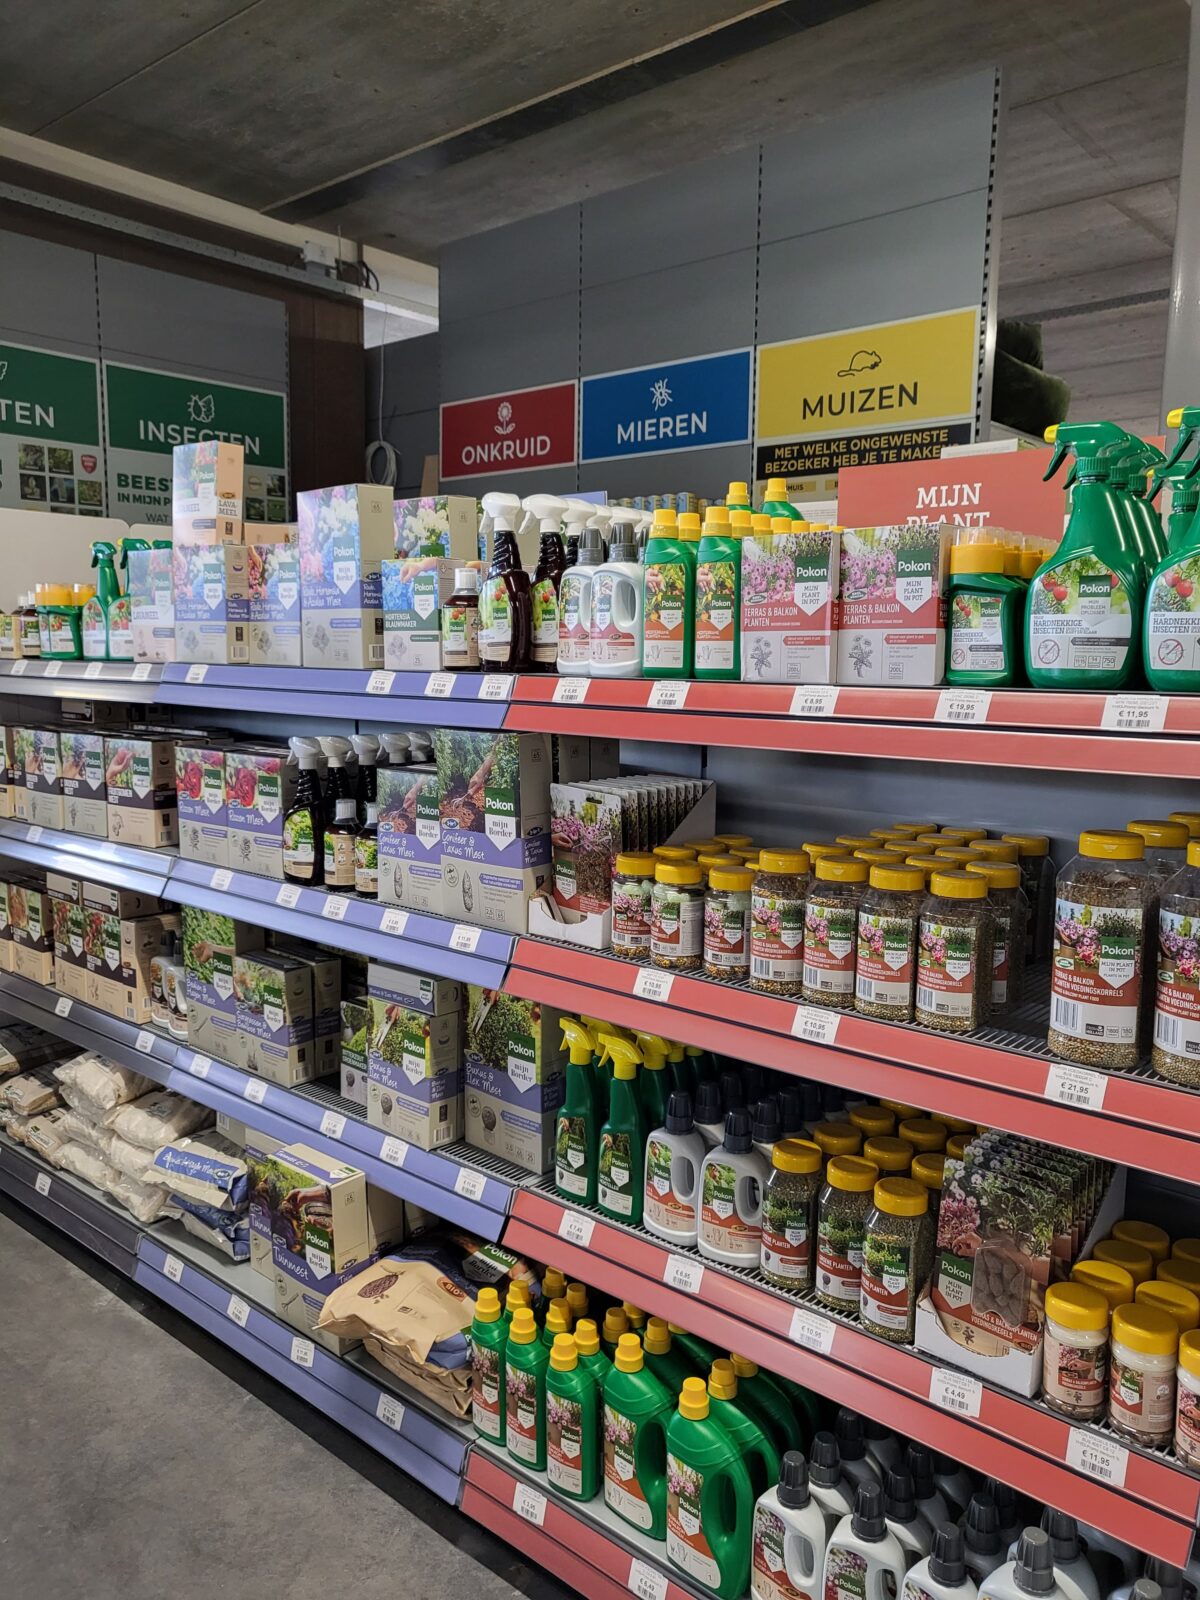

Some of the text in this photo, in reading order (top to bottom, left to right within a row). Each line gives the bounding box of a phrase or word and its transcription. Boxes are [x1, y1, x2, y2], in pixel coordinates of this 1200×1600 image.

[802, 381, 918, 420] MUIZEN
[617, 410, 709, 445] MIEREN
[139, 419, 260, 455] INSECTEN
[461, 435, 552, 466] ONKRUID
[774, 429, 950, 464] MET WELKE ONGEWENSTE
[765, 443, 960, 475] BEZOEKER HEB JE TE MAKE
[117, 492, 130, 504] IN
[132, 494, 164, 508] MIJN
[915, 482, 983, 510] MIJN
[145, 513, 169, 524] WAT
[796, 565, 829, 578] Pokon
[898, 560, 932, 573] Pokon
[414, 582, 435, 596] Pokon
[906, 580, 921, 588] MIJN
[1079, 583, 1111, 595] Pokon
[801, 591, 821, 599] PLANT
[903, 587, 923, 595] PLANT
[661, 600, 681, 608] Pokon
[711, 599, 731, 607] Pokon
[801, 598, 821, 606] IN POT
[903, 594, 923, 602] IN POT
[744, 607, 798, 617] TERRAS & BALKON
[843, 602, 901, 614] TERRAS & BALKON
[981, 607, 999, 615] Pokon
[386, 620, 417, 630] BLAUWMAKER
[744, 617, 770, 628] PLANTEN
[843, 614, 871, 626] PLANTEN
[1033, 619, 1083, 628] HARDNEKKIGE
[1032, 627, 1065, 636] INSECTEN
[1152, 625, 1190, 635] INSECTEN
[804, 697, 810, 705] €
[949, 702, 976, 712] € 19,95
[1118, 710, 1149, 719] € 11,95
[258, 782, 278, 794] Pokon
[416, 803, 440, 816] Pokon
[485, 796, 514, 813] Pokon
[421, 823, 435, 833] mijn
[492, 819, 508, 830] mijn
[418, 830, 439, 841] Border
[441, 830, 467, 846] Conifeer
[488, 827, 513, 839] Border
[379, 843, 416, 860] Taxus Mest
[442, 841, 487, 861] Taxus Mest
[725, 921, 742, 930] Pokon
[783, 921, 802, 931] Pokon
[829, 930, 851, 940] Pokon
[885, 940, 908, 950] Pokon
[1101, 944, 1134, 957] Pokon
[947, 950, 970, 960] Pokon
[212, 958, 232, 973] Pokon
[1073, 974, 1095, 986] BALKON
[1070, 981, 1124, 998] VOEDINGSKORRELS
[264, 992, 282, 1006] Pokon
[1173, 990, 1195, 1003] BALKON
[804, 1020, 826, 1031] € 10,95
[403, 1038, 425, 1056] Pokon
[507, 1038, 535, 1059] Pokon
[465, 1061, 487, 1080] Buxus
[513, 1061, 529, 1075] mijn
[381, 1073, 398, 1090] Mest
[510, 1068, 533, 1084] Border
[466, 1073, 502, 1098] Ilex Mest
[1060, 1081, 1089, 1095] € 21,95
[568, 1140, 584, 1150] Pokon
[611, 1156, 629, 1169] Pokon
[654, 1167, 669, 1178] Pokon
[713, 1189, 733, 1201] Pokon
[786, 1219, 806, 1228] Pokon
[305, 1230, 330, 1250] Pokon
[771, 1238, 791, 1250] PLANTEN
[484, 1241, 519, 1266] Pokon
[273, 1244, 309, 1283] Twinmest
[308, 1256, 330, 1275] Border
[832, 1260, 853, 1272] PLANTEN
[884, 1263, 905, 1276] Pokon
[470, 1260, 498, 1281] Border
[941, 1259, 972, 1282] Pokon
[869, 1283, 889, 1298] PLANTEN
[945, 1285, 964, 1298] PLANT
[947, 1279, 963, 1291] MIJN
[945, 1291, 963, 1303] IN POT
[800, 1322, 822, 1337] € 10,95
[971, 1316, 1014, 1340] VOEDINGSKEGELS
[1121, 1376, 1139, 1391] Pokon
[944, 1386, 966, 1400] € 4,49
[517, 1400, 535, 1414] Pokon
[561, 1427, 581, 1442] Pokon
[615, 1444, 633, 1462] Pokon
[1082, 1448, 1111, 1468] € 11,95
[678, 1497, 699, 1517] Pokon
[765, 1537, 782, 1555] Pokon
[838, 1576, 862, 1595] Pokon
